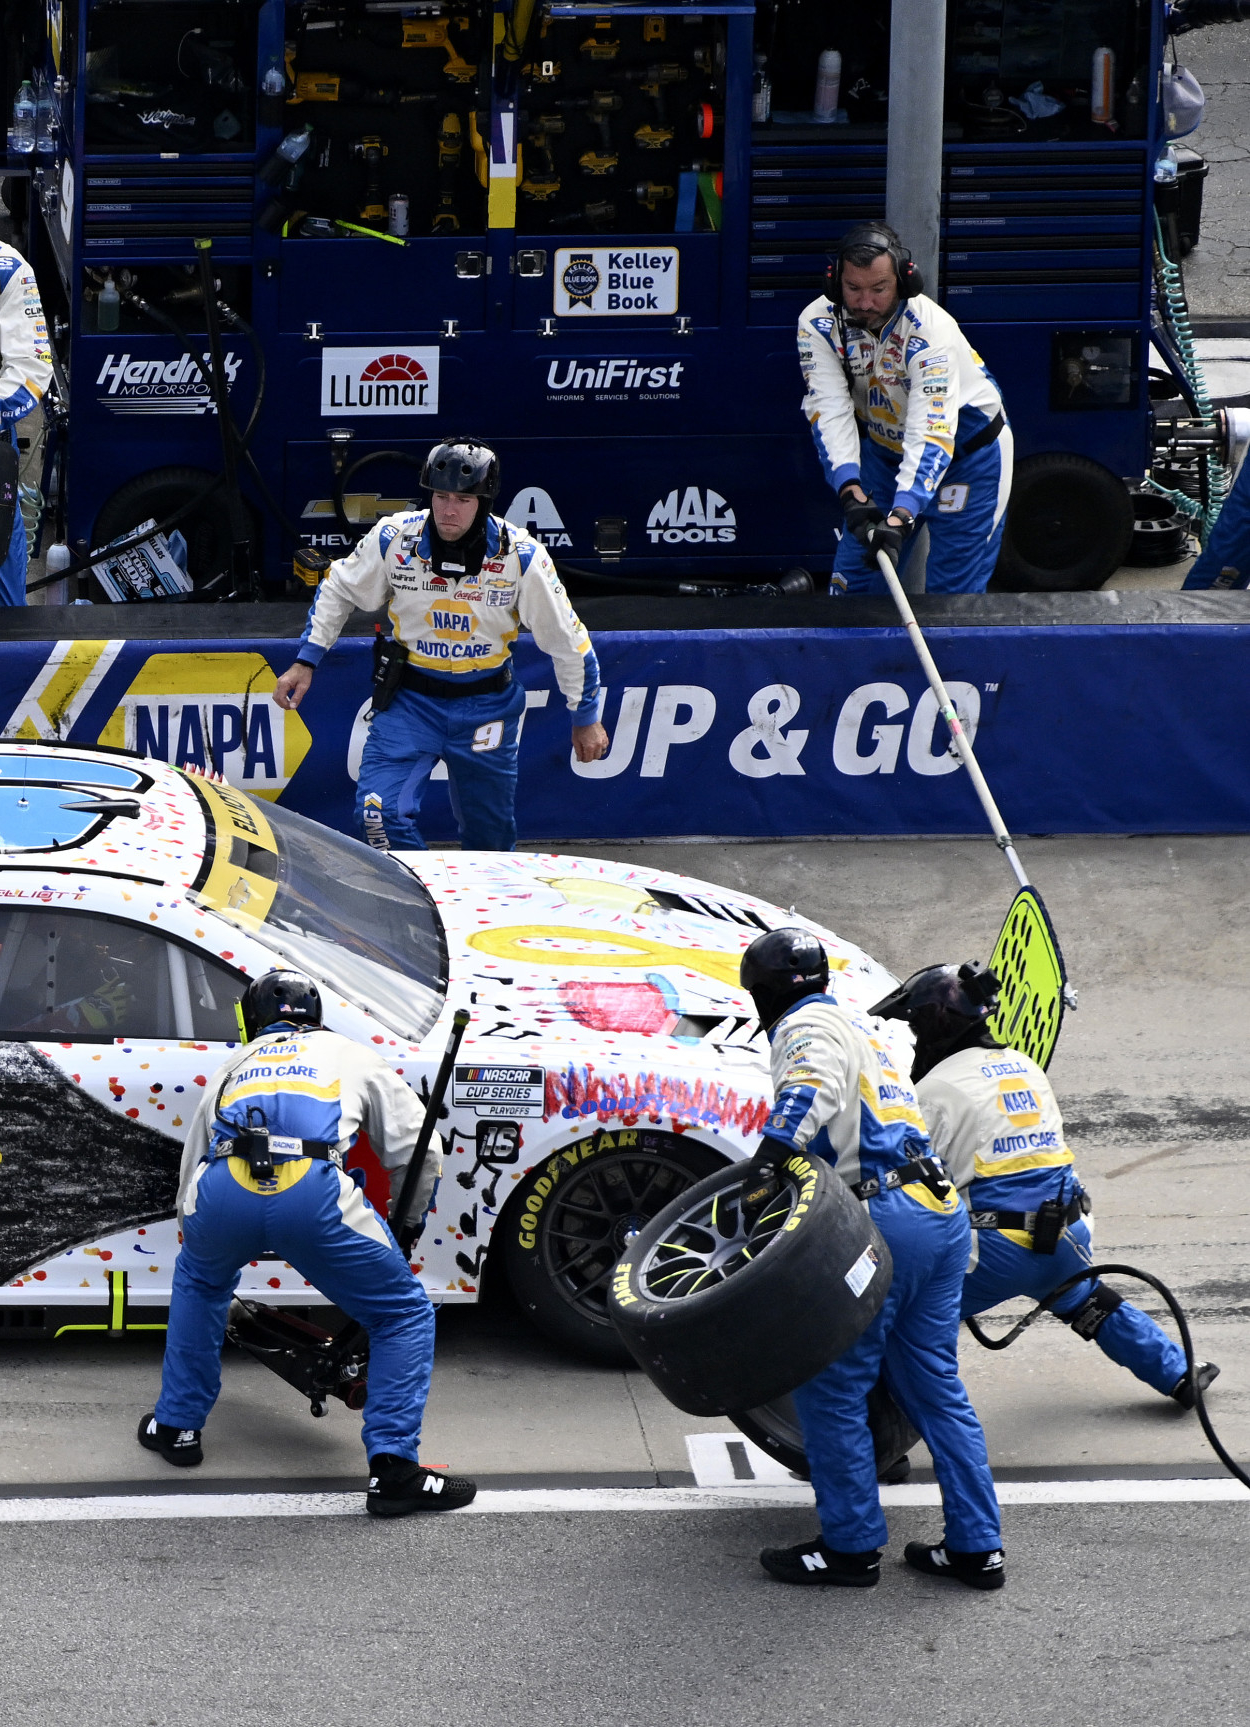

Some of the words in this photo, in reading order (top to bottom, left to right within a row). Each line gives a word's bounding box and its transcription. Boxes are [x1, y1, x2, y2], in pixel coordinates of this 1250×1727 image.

[568, 264, 596, 275] KELLEY
[608, 253, 673, 272] Kelley
[564, 276, 580, 284] BLUE
[581, 276, 598, 284] BOOK
[608, 274, 654, 290] Blue
[608, 293, 658, 310] Book
[96, 352, 242, 394] Hendrik
[547, 360, 685, 389] UniFirst
[120, 383, 233, 397] MOTORSPOS
[331, 375, 430, 407] LLumar
[648, 486, 737, 528] MAC
[938, 484, 970, 513] 9
[403, 515, 425, 524] NAPA
[647, 528, 737, 544] TOOLS
[118, 555, 149, 593] BOX
[390, 573, 416, 582] UniFirst
[434, 612, 470, 632] NAPA
[416, 640, 449, 658] AUTO
[452, 643, 492, 658] CARE
[471, 720, 504, 752] 9
[570, 685, 716, 779] UP
[728, 683, 809, 778] &
[831, 682, 981, 777] GO
[136, 703, 275, 778] NAPA
[258, 1044, 298, 1056] NAPA
[236, 1067, 272, 1085] AUTO
[276, 1065, 319, 1079] CARE
[482, 1069, 531, 1082] NASCAR
[982, 1060, 1028, 1078] O'DELL
[466, 1087, 490, 1098] CUP
[491, 1087, 532, 1099] SERIES
[1002, 1090, 1038, 1113] NAPA
[489, 1106, 530, 1115] PLAYOFFS
[272, 1140, 295, 1151] RACING
[483, 1127, 518, 1157] 16
[993, 1135, 1028, 1154] AUTO
[1029, 1131, 1059, 1149] CARE
[519, 1129, 638, 1250] GOODYEAR
[612, 1262, 638, 1307] EAGLE
[423, 1475, 444, 1494] N
[801, 1552, 828, 1571] N
